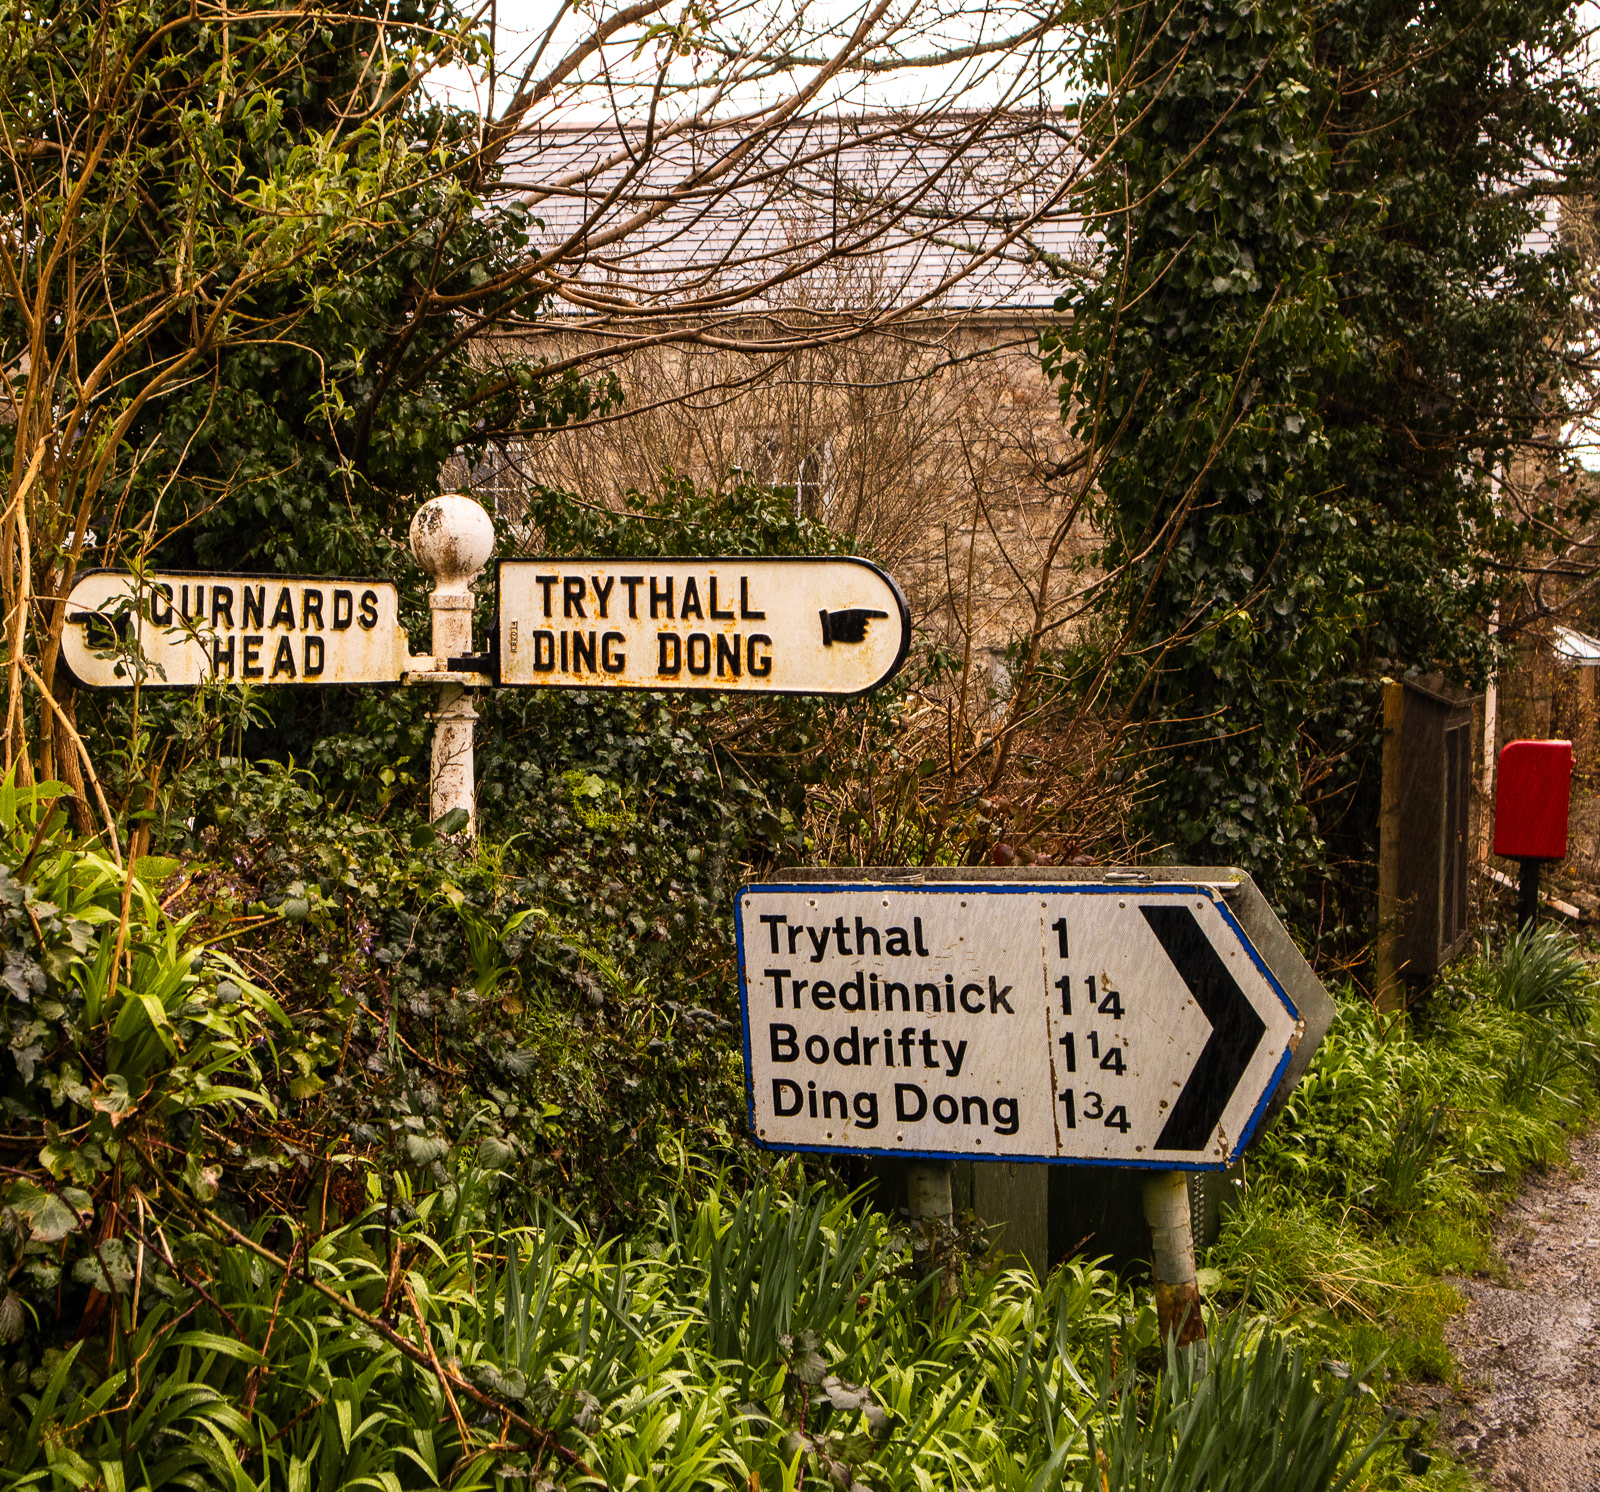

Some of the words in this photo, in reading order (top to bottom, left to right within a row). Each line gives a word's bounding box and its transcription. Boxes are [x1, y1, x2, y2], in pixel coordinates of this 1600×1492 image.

[150, 581, 380, 631] GURNARDS
[535, 575, 766, 620] TRYTHALL
[212, 634, 326, 679] HEAD
[532, 630, 626, 674] DING
[657, 632, 773, 677] DONG
[759, 914, 930, 963] Trythal
[1051, 917, 1069, 959] 1
[763, 968, 1015, 1015] Tredinnick
[769, 1023, 968, 1078] Bodrifty
[771, 1078, 879, 1130] Ding
[894, 1083, 1020, 1135] Dong
